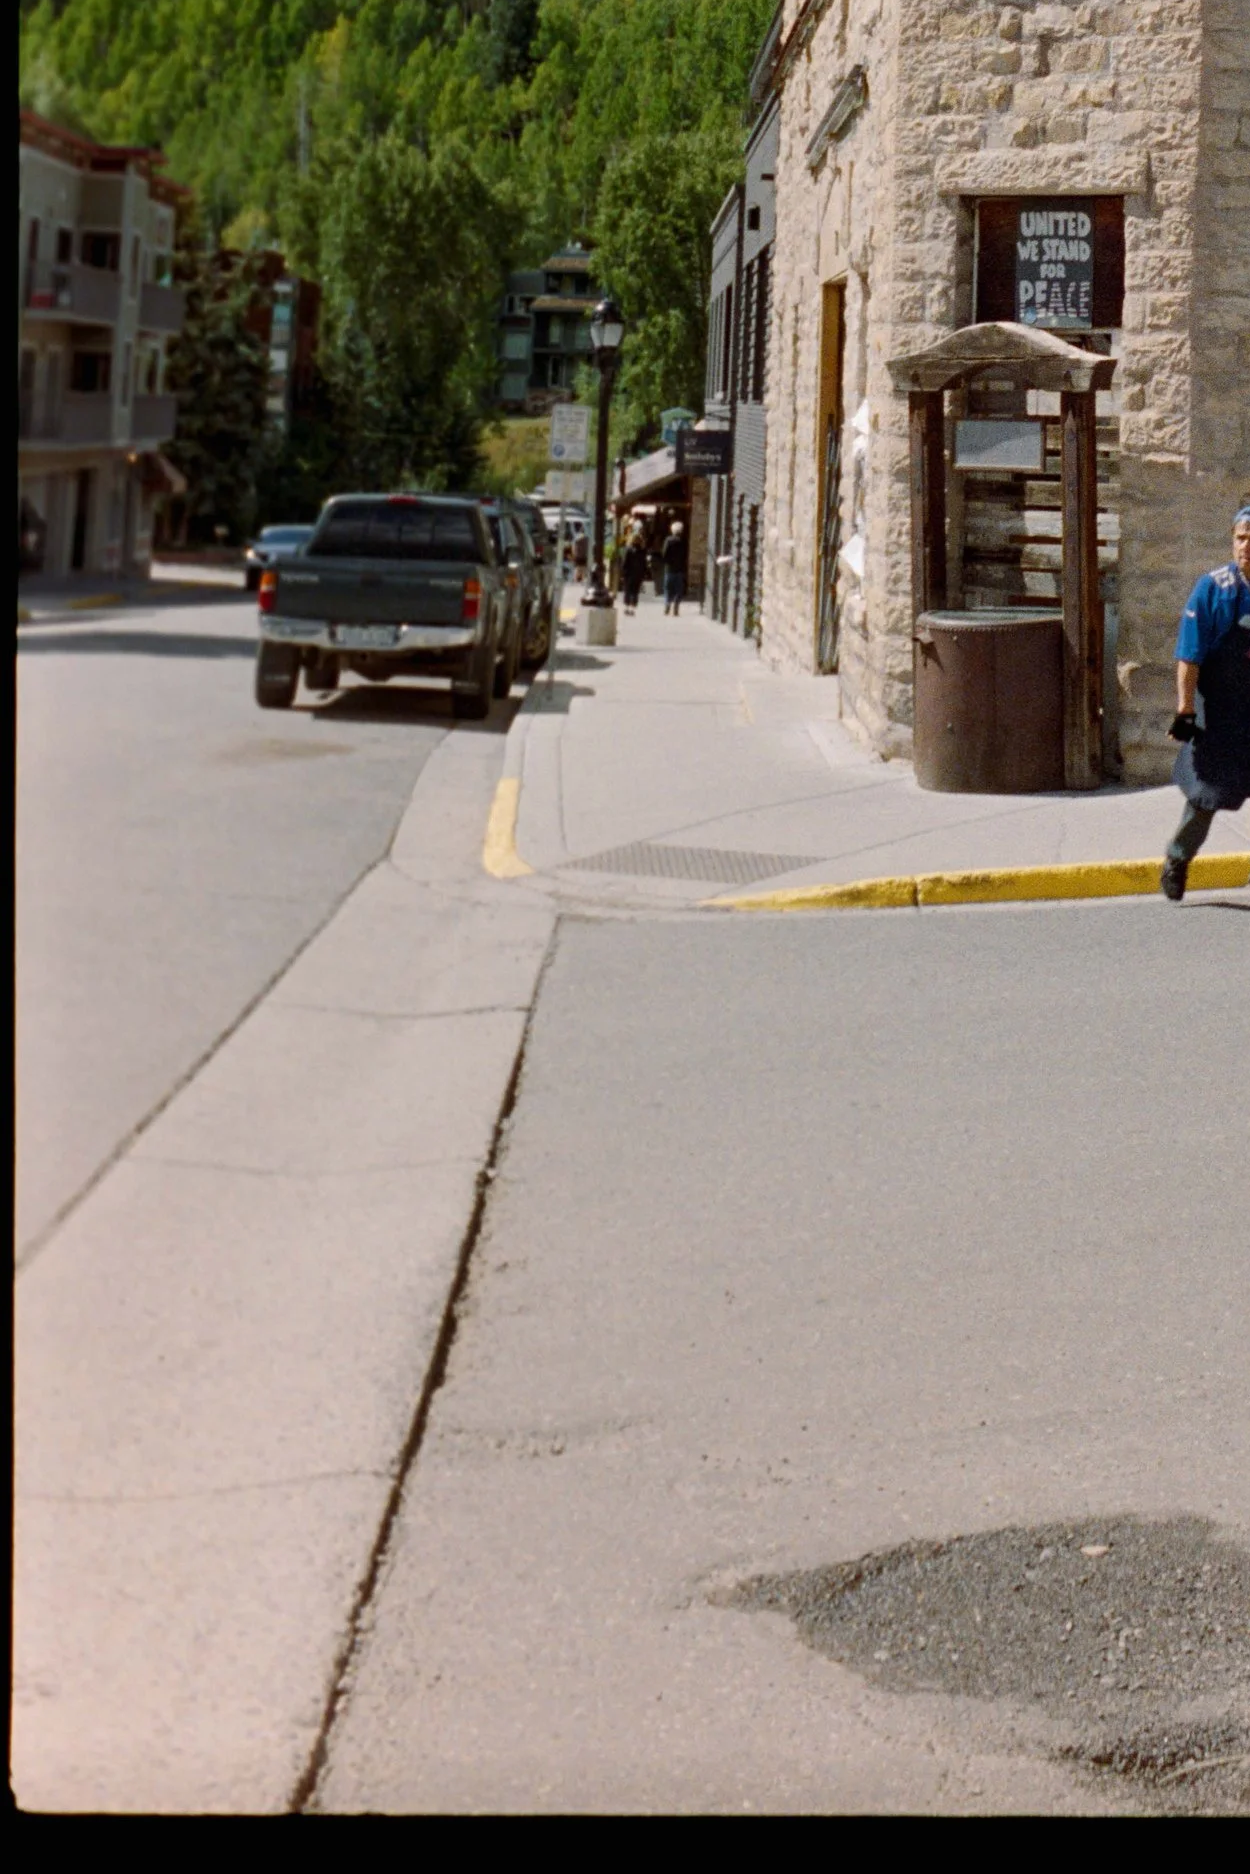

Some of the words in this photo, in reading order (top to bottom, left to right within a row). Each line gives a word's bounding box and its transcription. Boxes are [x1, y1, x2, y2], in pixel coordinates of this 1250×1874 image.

[1020, 211, 1092, 238] UNITED
[1016, 239, 1041, 262] WE
[1042, 238, 1092, 263] STAND
[1040, 263, 1067, 279] FOR
[1019, 280, 1091, 319] PEACE
